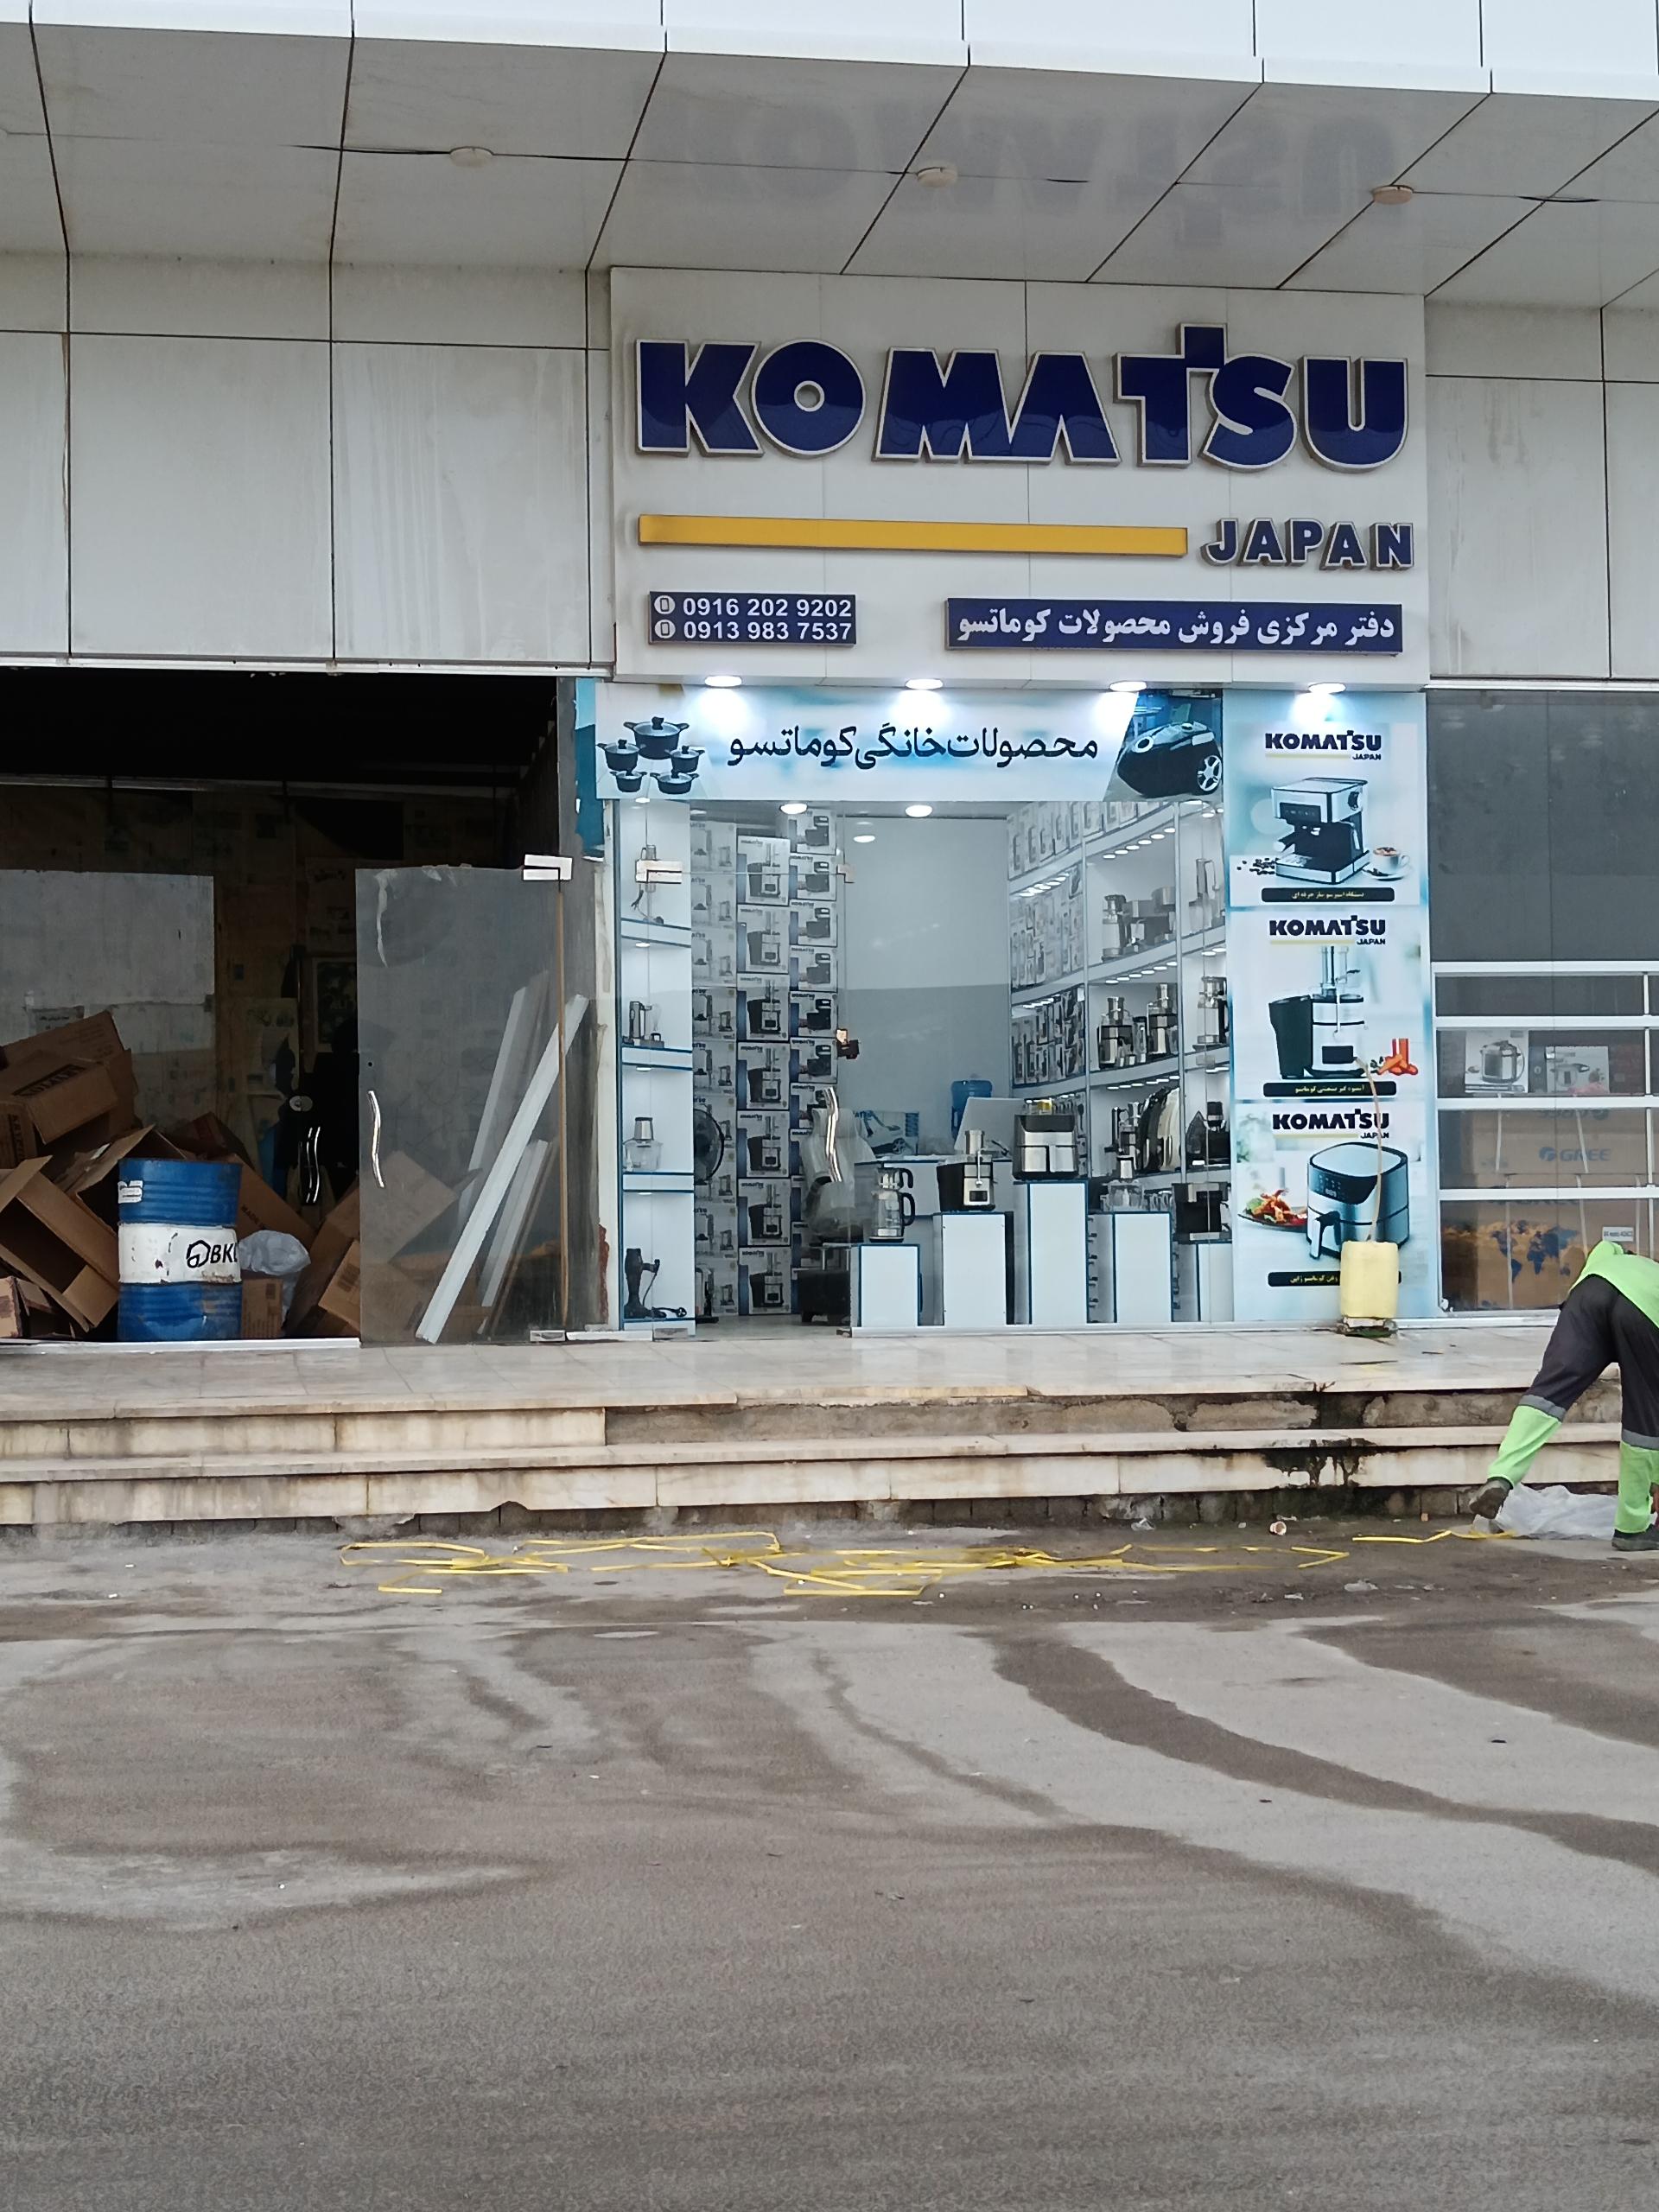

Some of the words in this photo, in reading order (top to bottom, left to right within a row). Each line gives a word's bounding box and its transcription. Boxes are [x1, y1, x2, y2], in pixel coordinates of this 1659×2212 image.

[634, 322, 1410, 474] KOMATSU
[1202, 518, 1415, 569] JAPAN
[683, 597, 740, 616] 0916
[747, 598, 789, 617] 202
[796, 599, 852, 618] 9202
[957, 607, 1052, 641] کوماتسو
[683, 620, 740, 639] 0913
[747, 621, 790, 640] 983
[797, 622, 852, 640] 7537
[1058, 607, 1172, 644] محصولات
[1177, 609, 1250, 645] فروش
[1256, 612, 1338, 645] مرکزی
[1344, 615, 1395, 648] دفتر
[727, 724, 857, 767] کوماتسو
[855, 722, 947, 770] خانگی
[947, 727, 1098, 768] محصولات
[1265, 730, 1382, 752] KOMATSU
[1269, 915, 1386, 936] KOMATSU
[1273, 1109, 1389, 1130] KOMATSU
